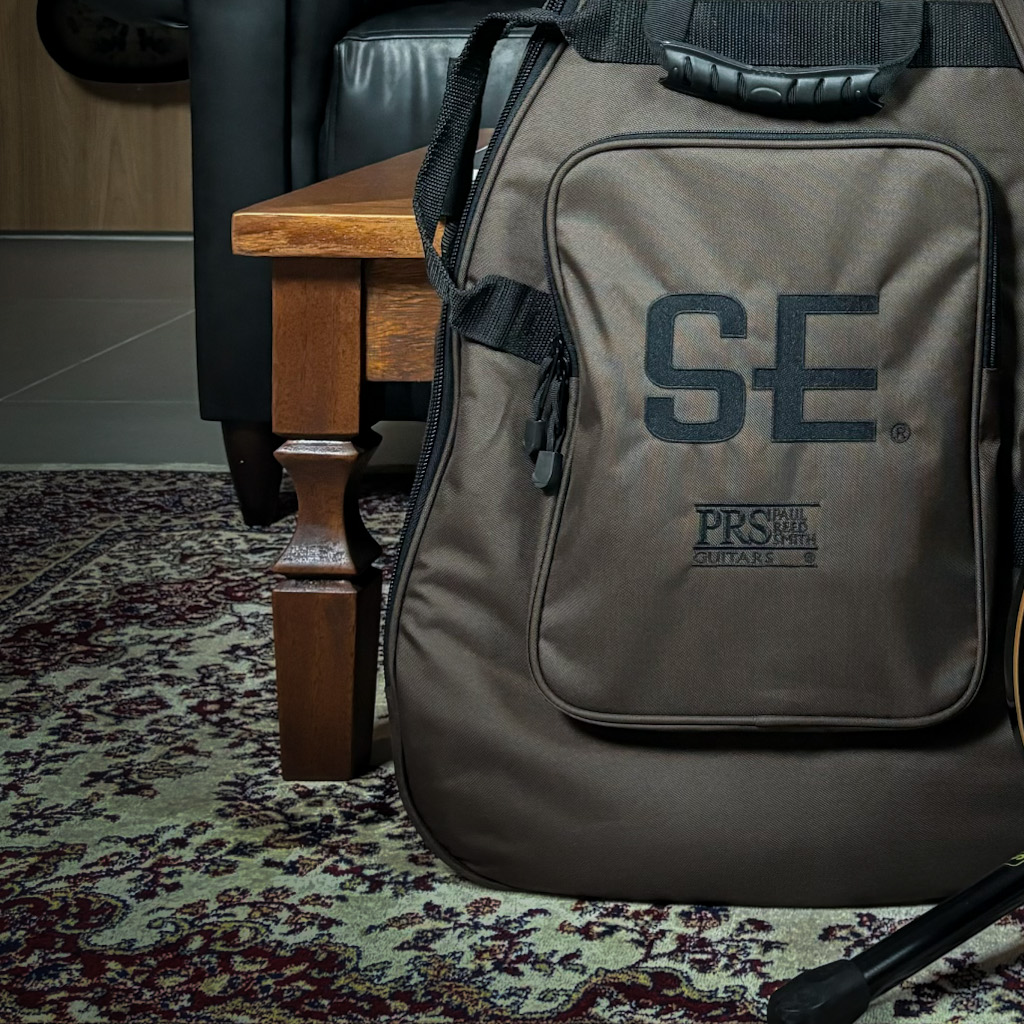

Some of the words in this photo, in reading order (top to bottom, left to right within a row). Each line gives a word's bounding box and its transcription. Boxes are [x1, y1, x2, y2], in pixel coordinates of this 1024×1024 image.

[644, 293, 879, 444] SE
[772, 509, 807, 522] PAUL
[696, 509, 772, 546] PRS
[773, 522, 809, 534] REED
[773, 533, 817, 546] SMITH
[693, 552, 774, 564] GUITARS
